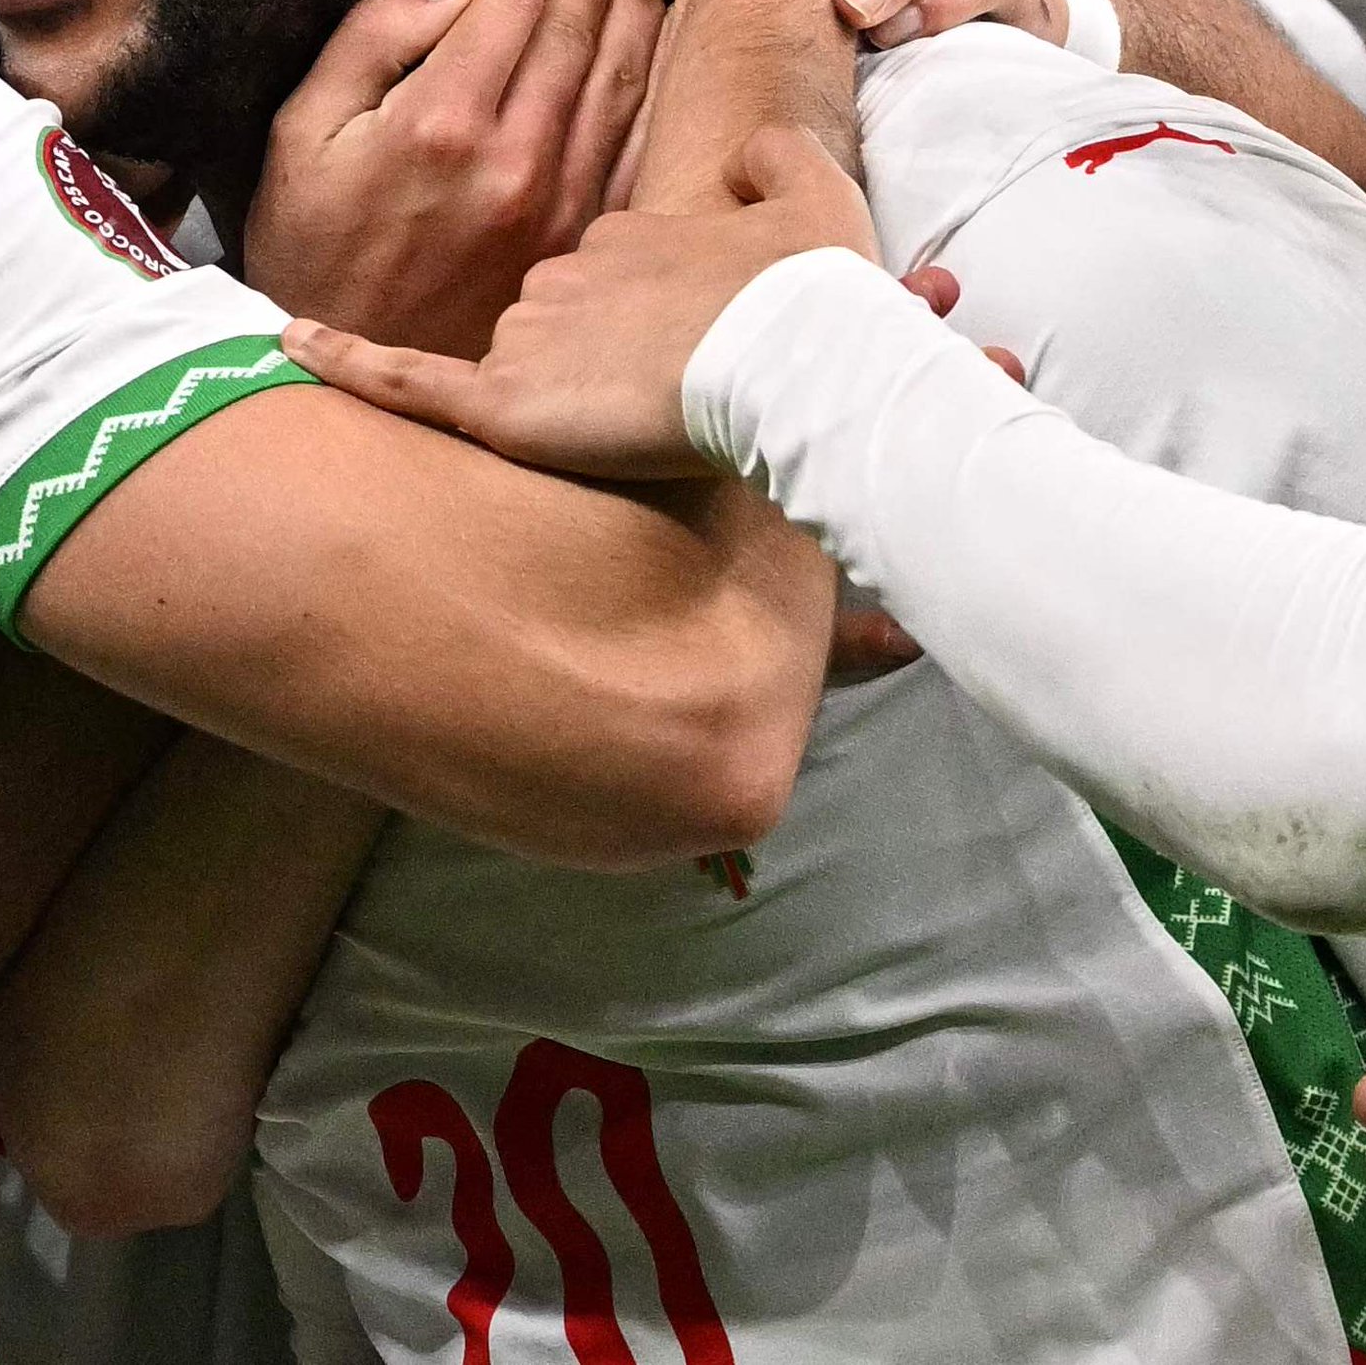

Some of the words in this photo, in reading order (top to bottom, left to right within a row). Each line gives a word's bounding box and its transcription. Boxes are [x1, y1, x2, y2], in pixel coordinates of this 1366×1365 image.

[52, 146, 75, 184] CAF
[64, 185, 91, 207] 25
[84, 209, 175, 277] OROCCO
